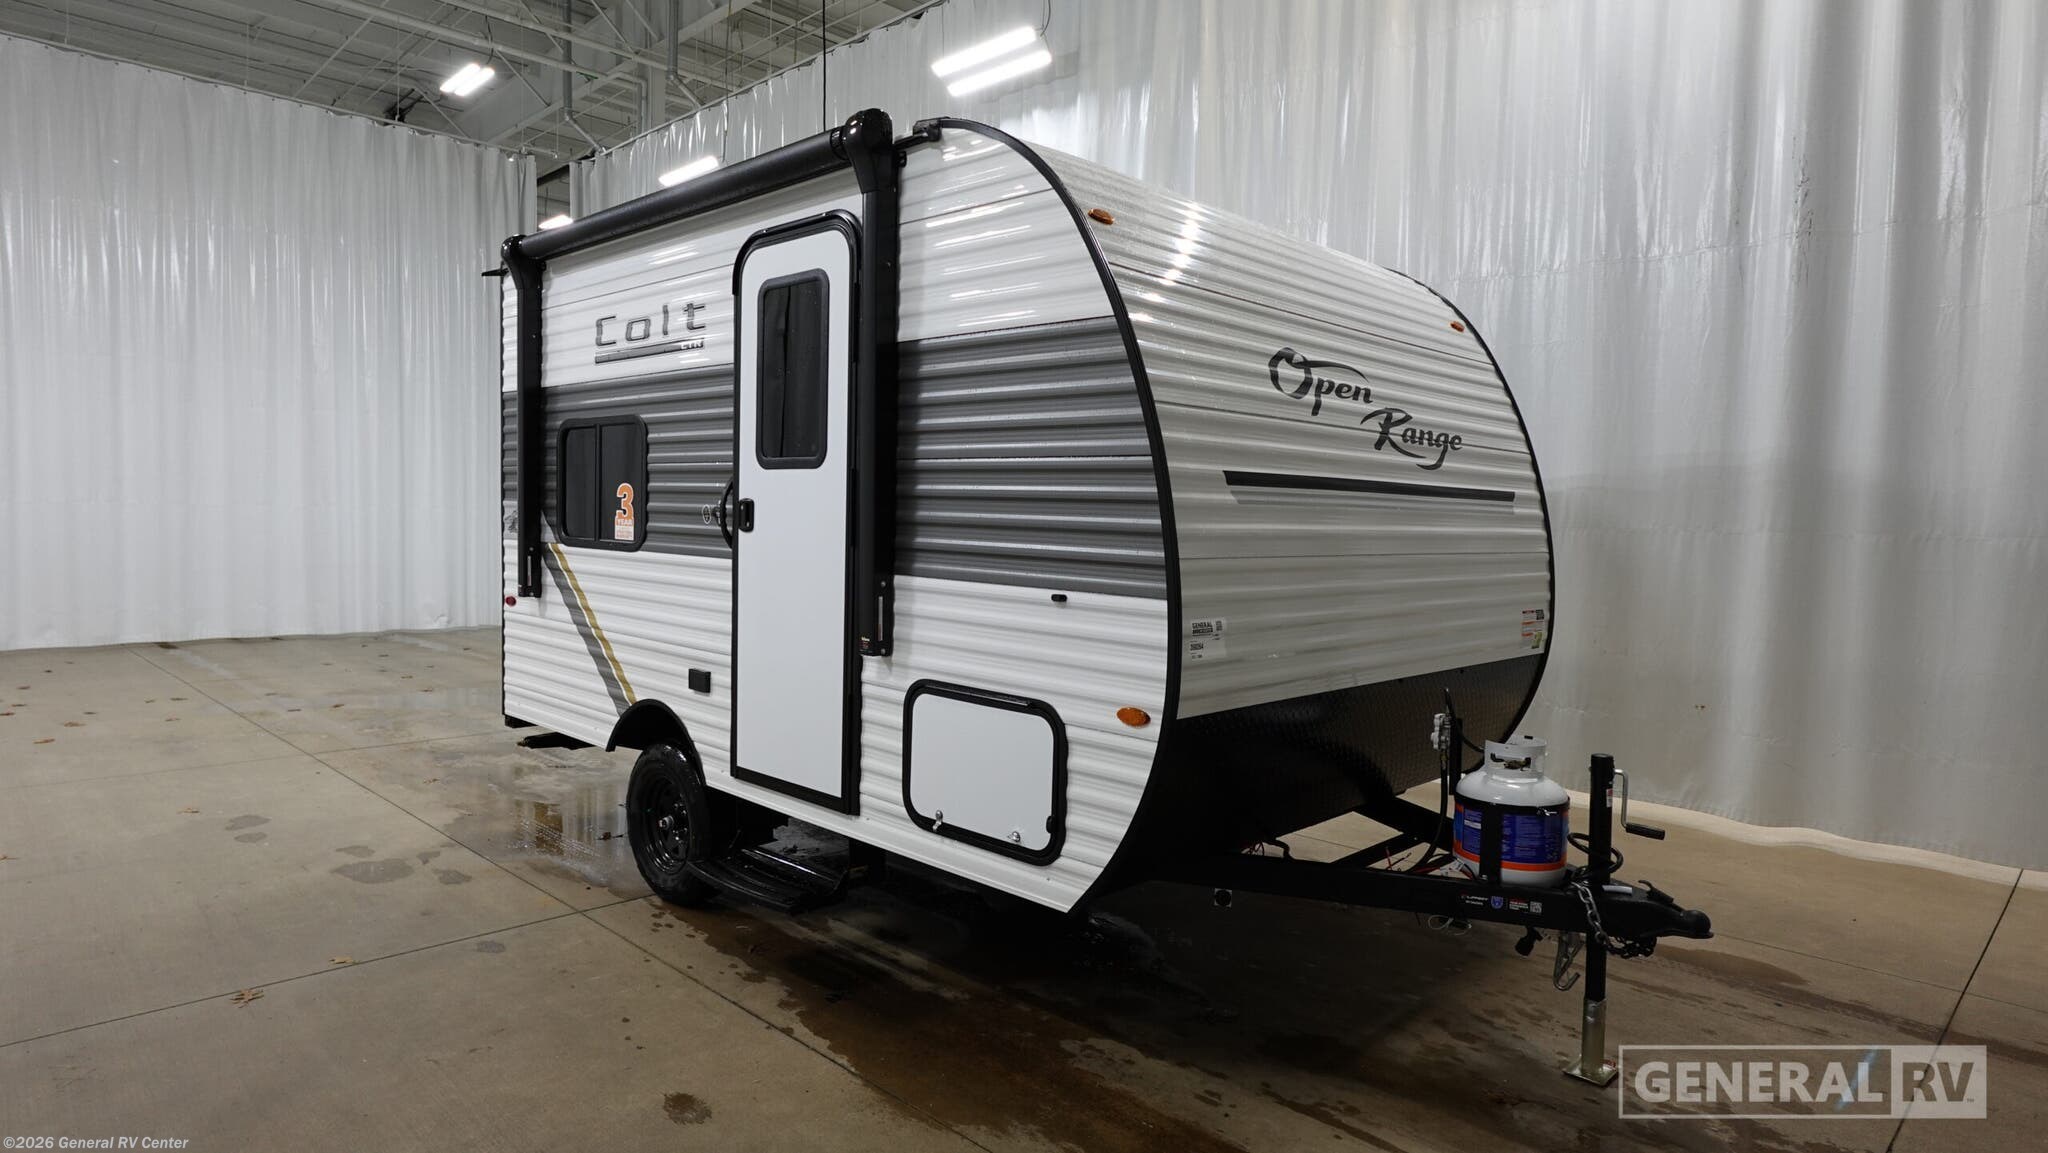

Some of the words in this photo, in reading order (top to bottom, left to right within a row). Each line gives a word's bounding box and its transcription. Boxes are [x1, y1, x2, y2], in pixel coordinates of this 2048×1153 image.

[595, 303, 705, 346] Colt
[1268, 347, 1373, 416] Open
[1360, 407, 1463, 470] Range
[616, 483, 634, 520] 3
